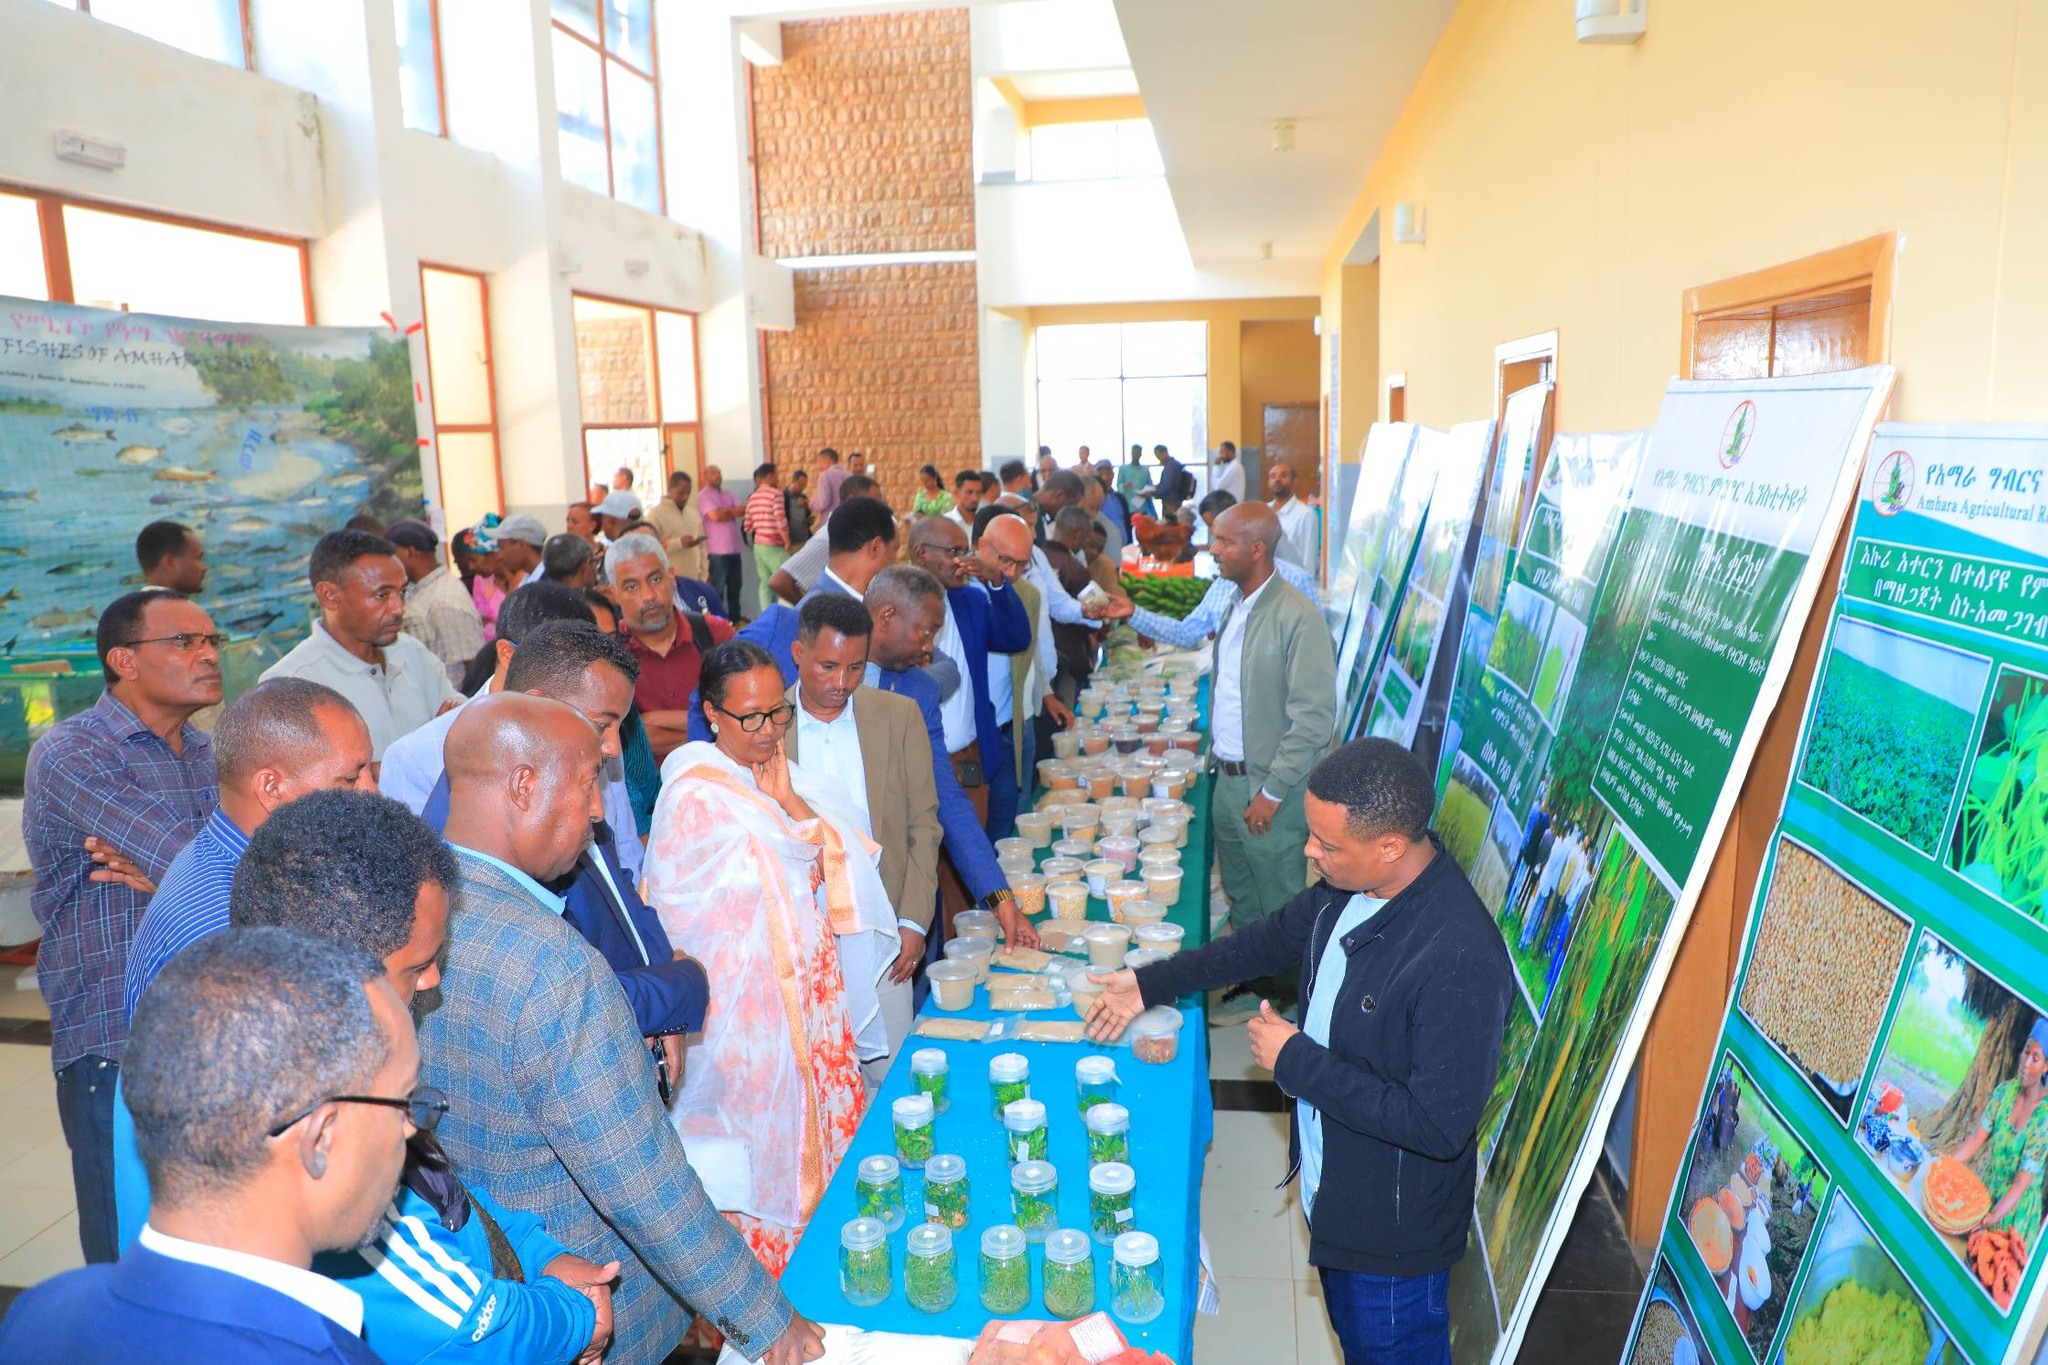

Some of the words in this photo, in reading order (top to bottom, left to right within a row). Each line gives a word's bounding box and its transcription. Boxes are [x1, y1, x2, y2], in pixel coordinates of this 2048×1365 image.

[88, 345, 109, 362] OF
[1926, 463, 1977, 489] የአማራ
[1989, 466, 2044, 493] ግብርና
[1917, 496, 1958, 514] Amhara
[1961, 499, 2034, 522] Agricultural
[1949, 561, 2011, 593] በተለያዩ
[472, 1294, 496, 1341] adidas
